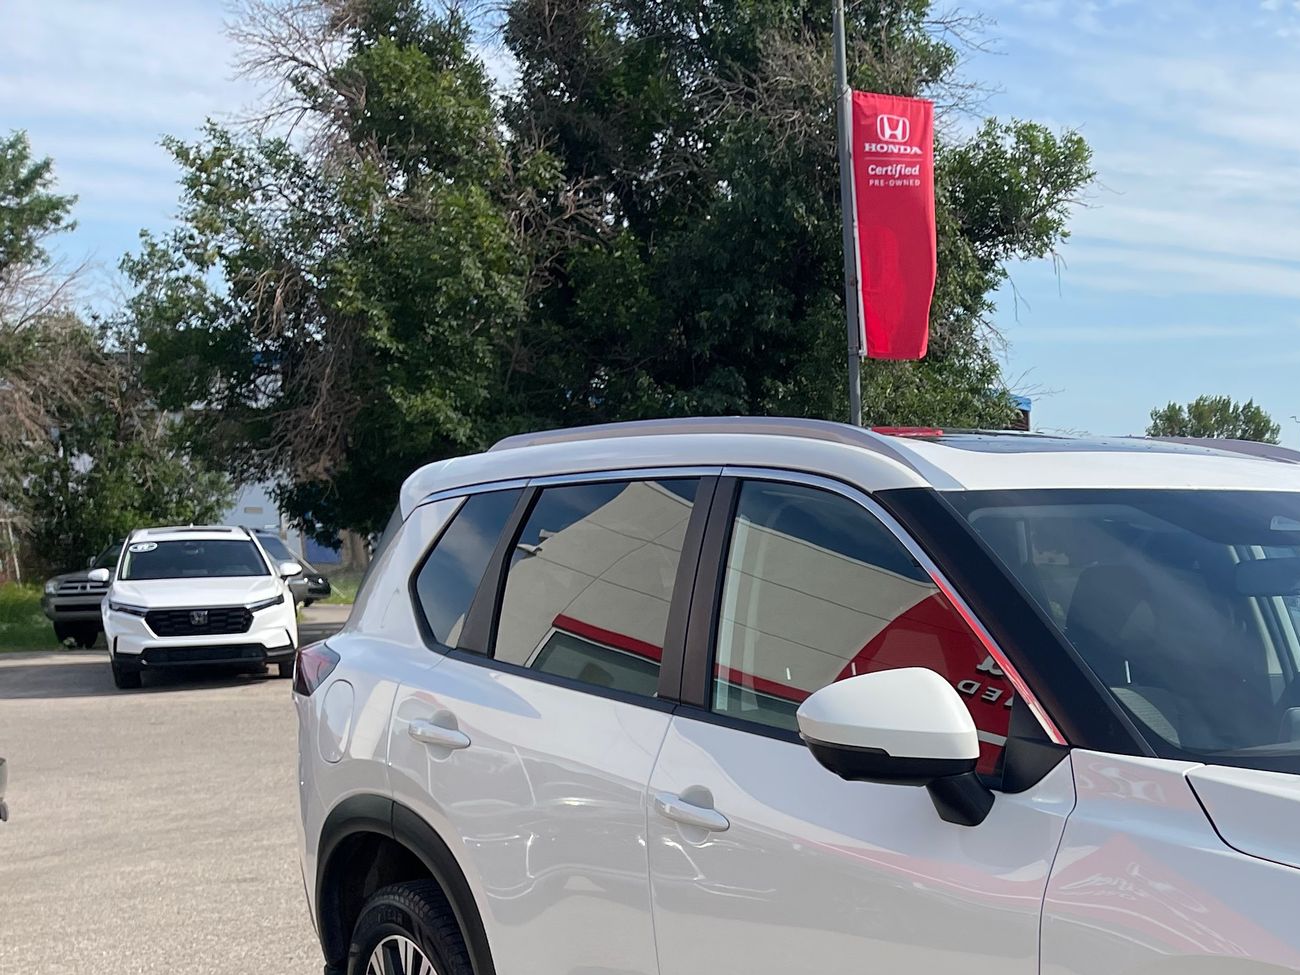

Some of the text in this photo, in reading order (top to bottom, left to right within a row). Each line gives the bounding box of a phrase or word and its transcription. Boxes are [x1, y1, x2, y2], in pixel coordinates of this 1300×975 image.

[864, 143, 923, 154] HONDA
[868, 164, 919, 177] Certified
[869, 179, 921, 187] PRE-OWNED
